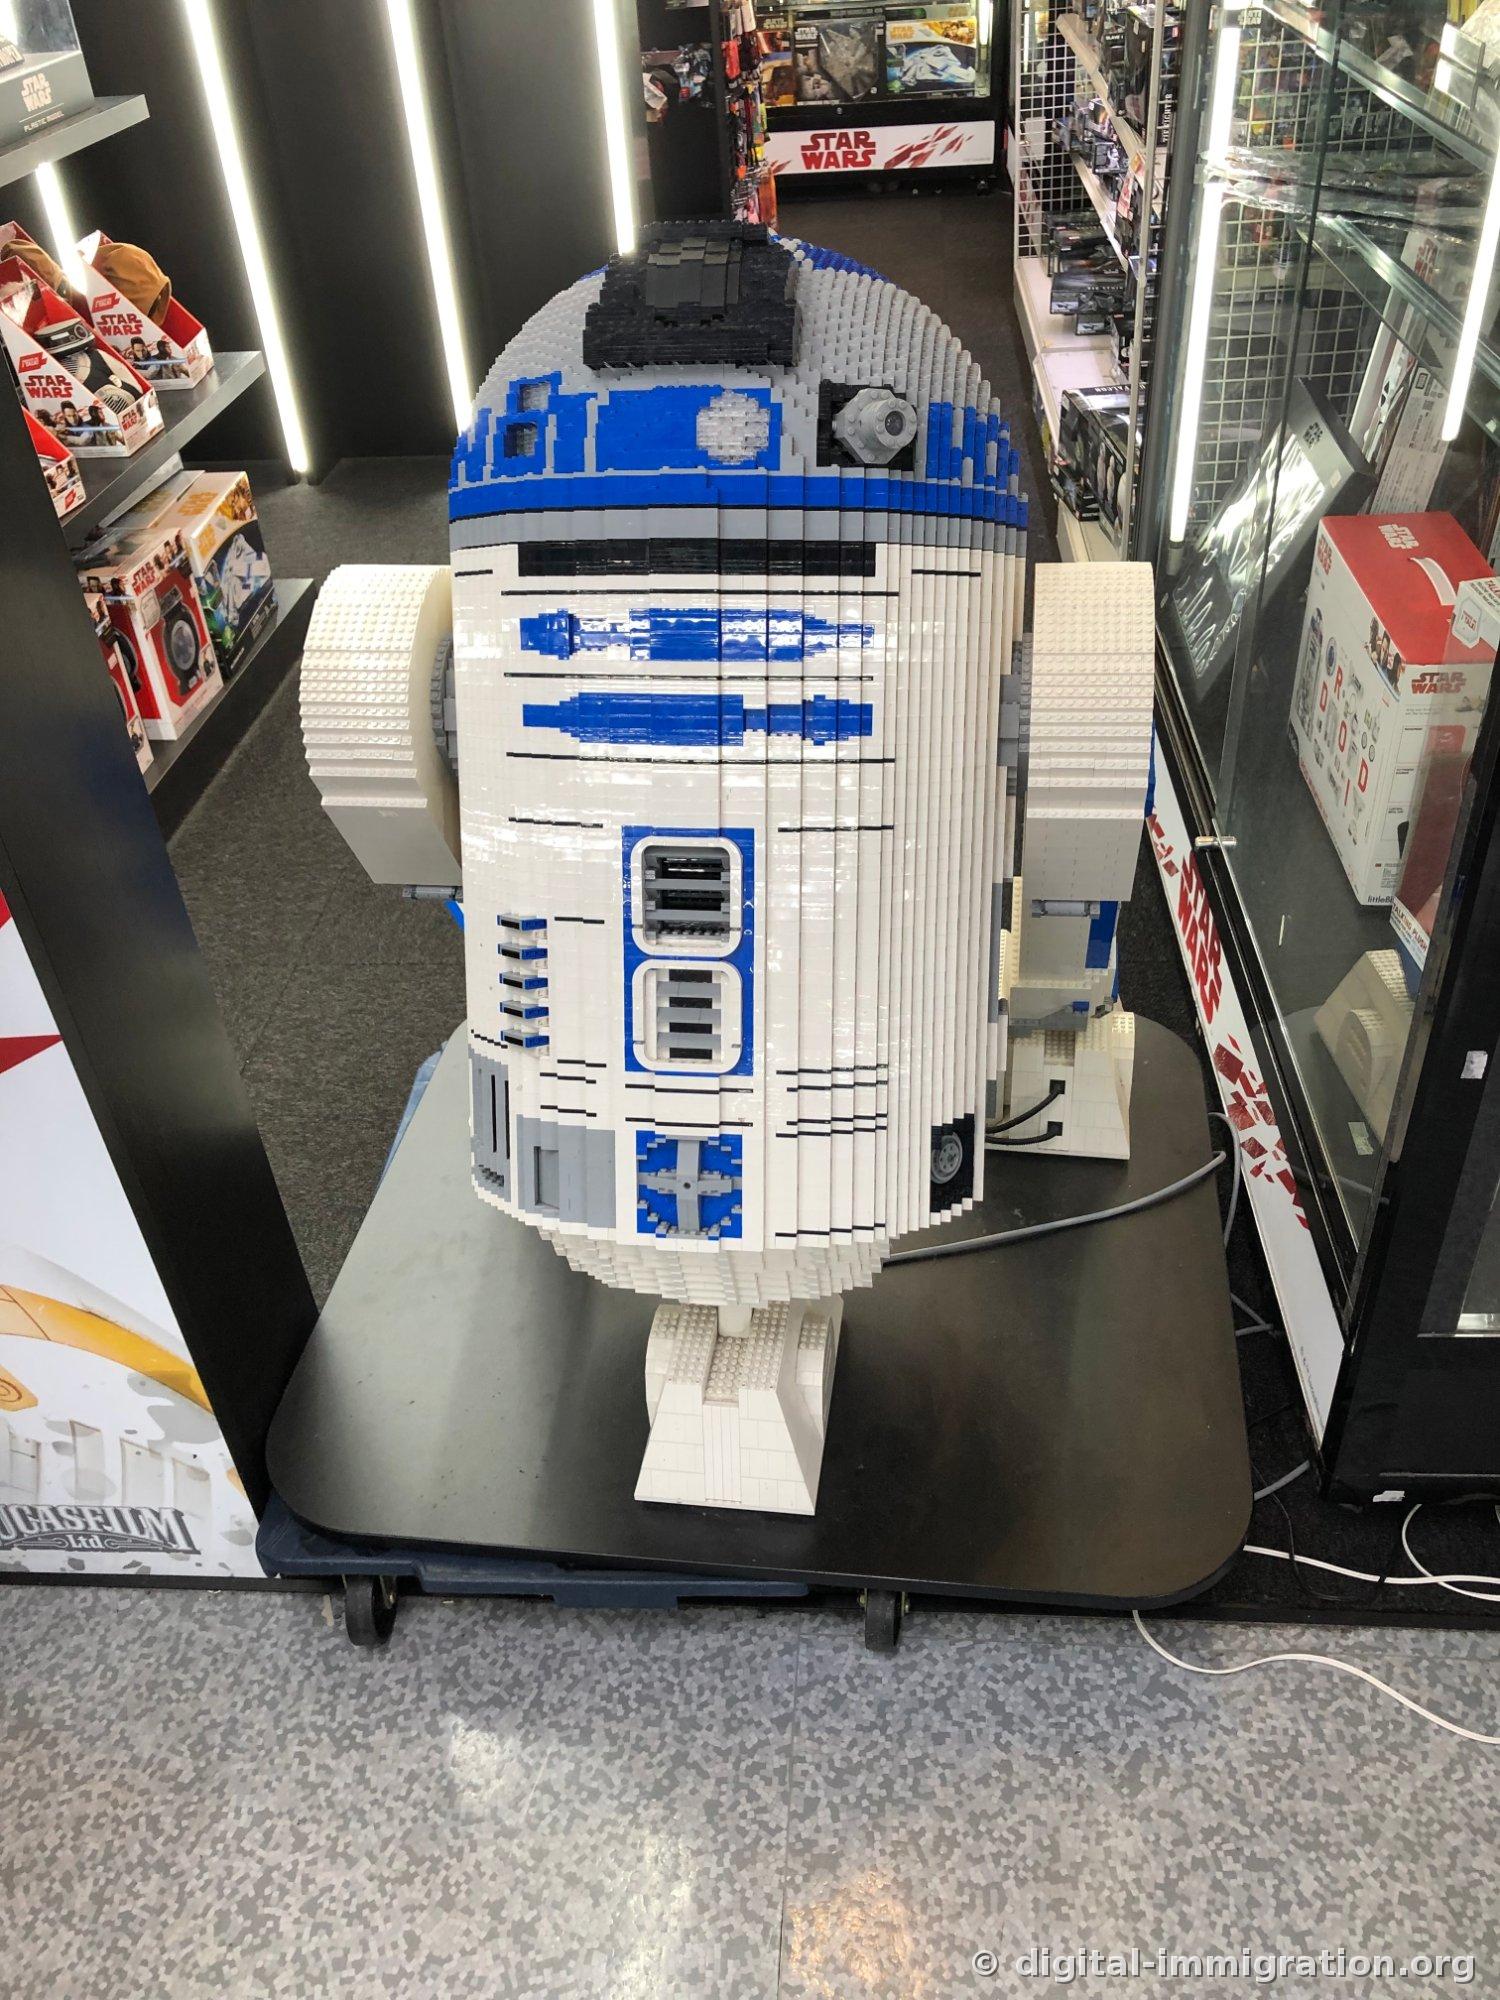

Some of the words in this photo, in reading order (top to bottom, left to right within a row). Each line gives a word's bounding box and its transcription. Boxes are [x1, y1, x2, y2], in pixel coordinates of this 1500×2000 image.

[21, 72, 50, 97] STAR
[801, 130, 876, 152] STAR
[801, 147, 876, 170] WARS
[97, 313, 143, 326] STAR
[97, 324, 143, 337] WARS
[24, 375, 72, 387] STAR
[25, 386, 73, 399] WARS
[132, 562, 155, 586] STAR
[133, 573, 156, 597] WARS
[1411, 682, 1466, 694] WARS
[1412, 672, 1467, 684] STAR
[1182, 850, 1222, 999] STAR
[1178, 868, 1220, 1024] WARS
[0, 1504, 196, 1551] UCASFILM
[67, 1534, 104, 1549] Ltd
